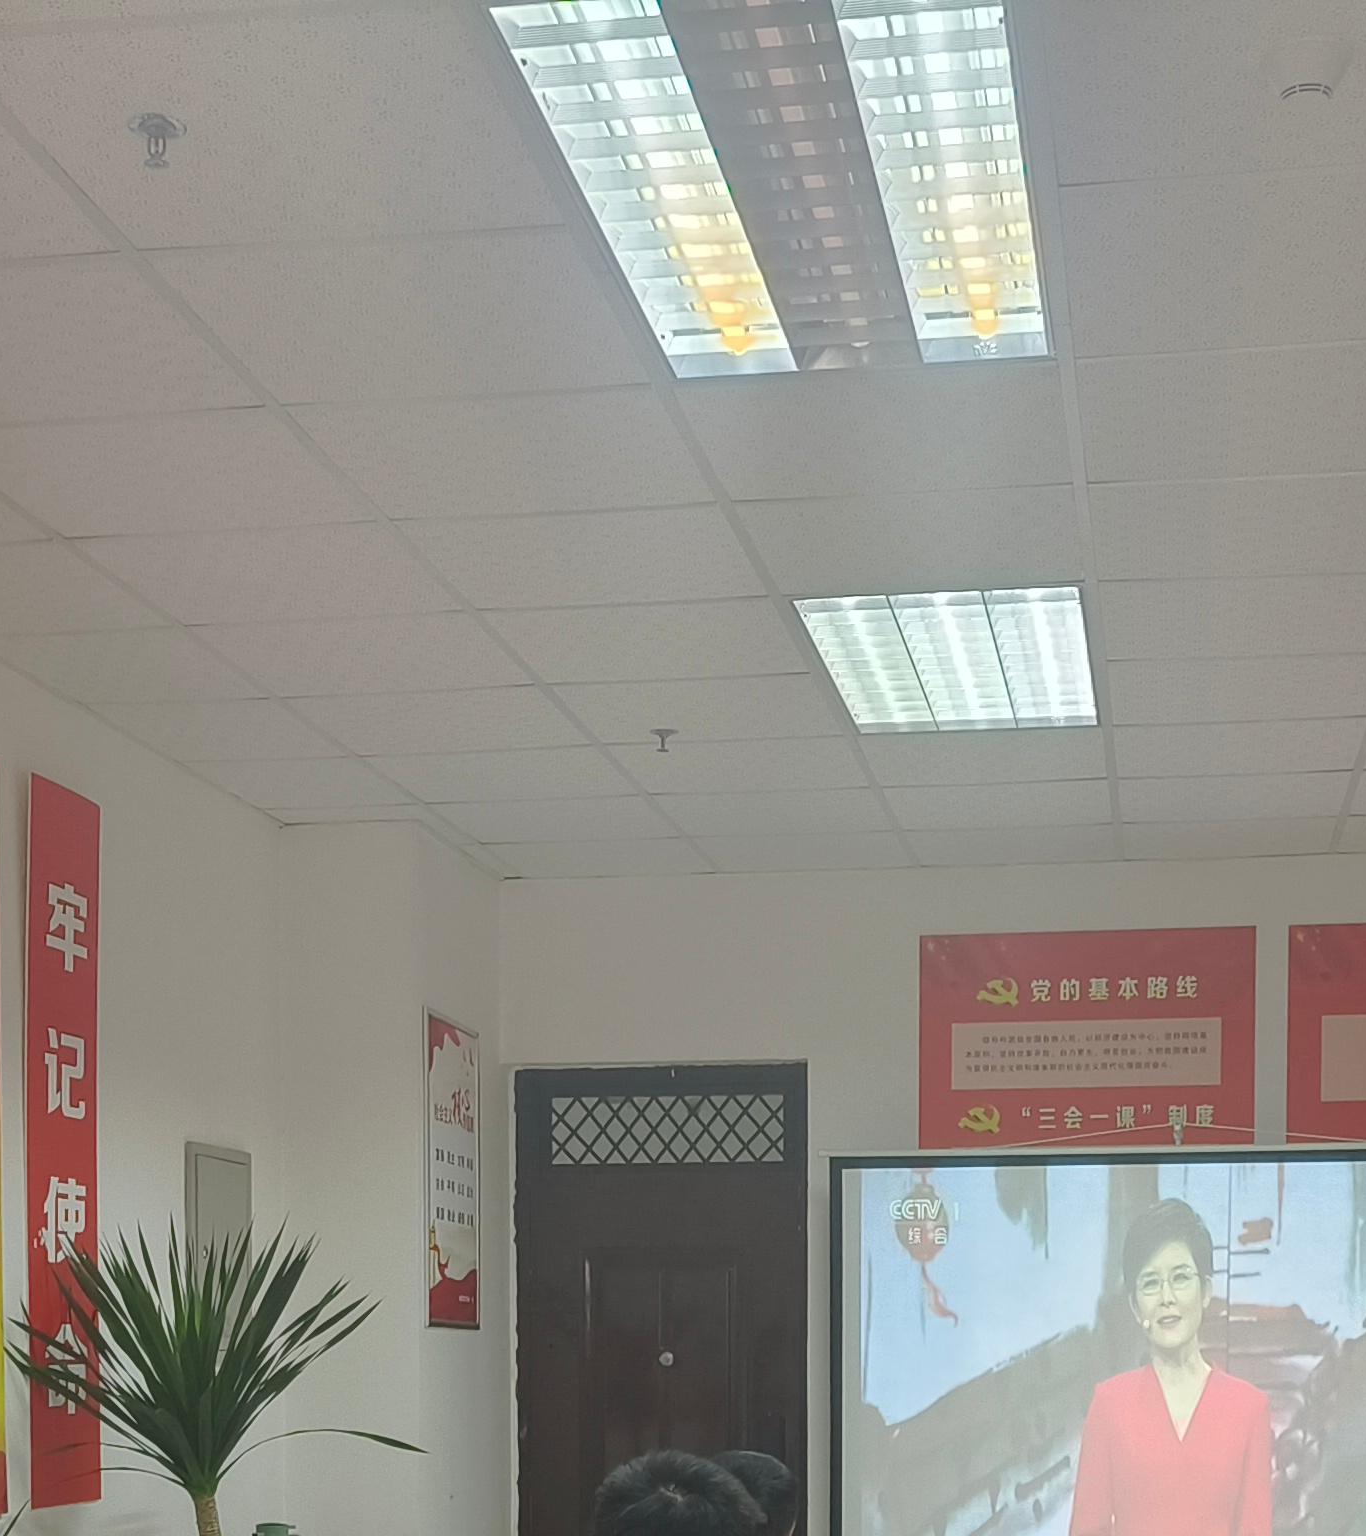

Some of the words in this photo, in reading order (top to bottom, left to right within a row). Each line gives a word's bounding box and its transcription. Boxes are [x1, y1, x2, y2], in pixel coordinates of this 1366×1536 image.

[1030, 975, 1198, 1003] 党的基本路线
[43, 883, 88, 1415] 牢记使命
[889, 1199, 942, 1221] CCTV
[908, 1227, 948, 1245] 综合
